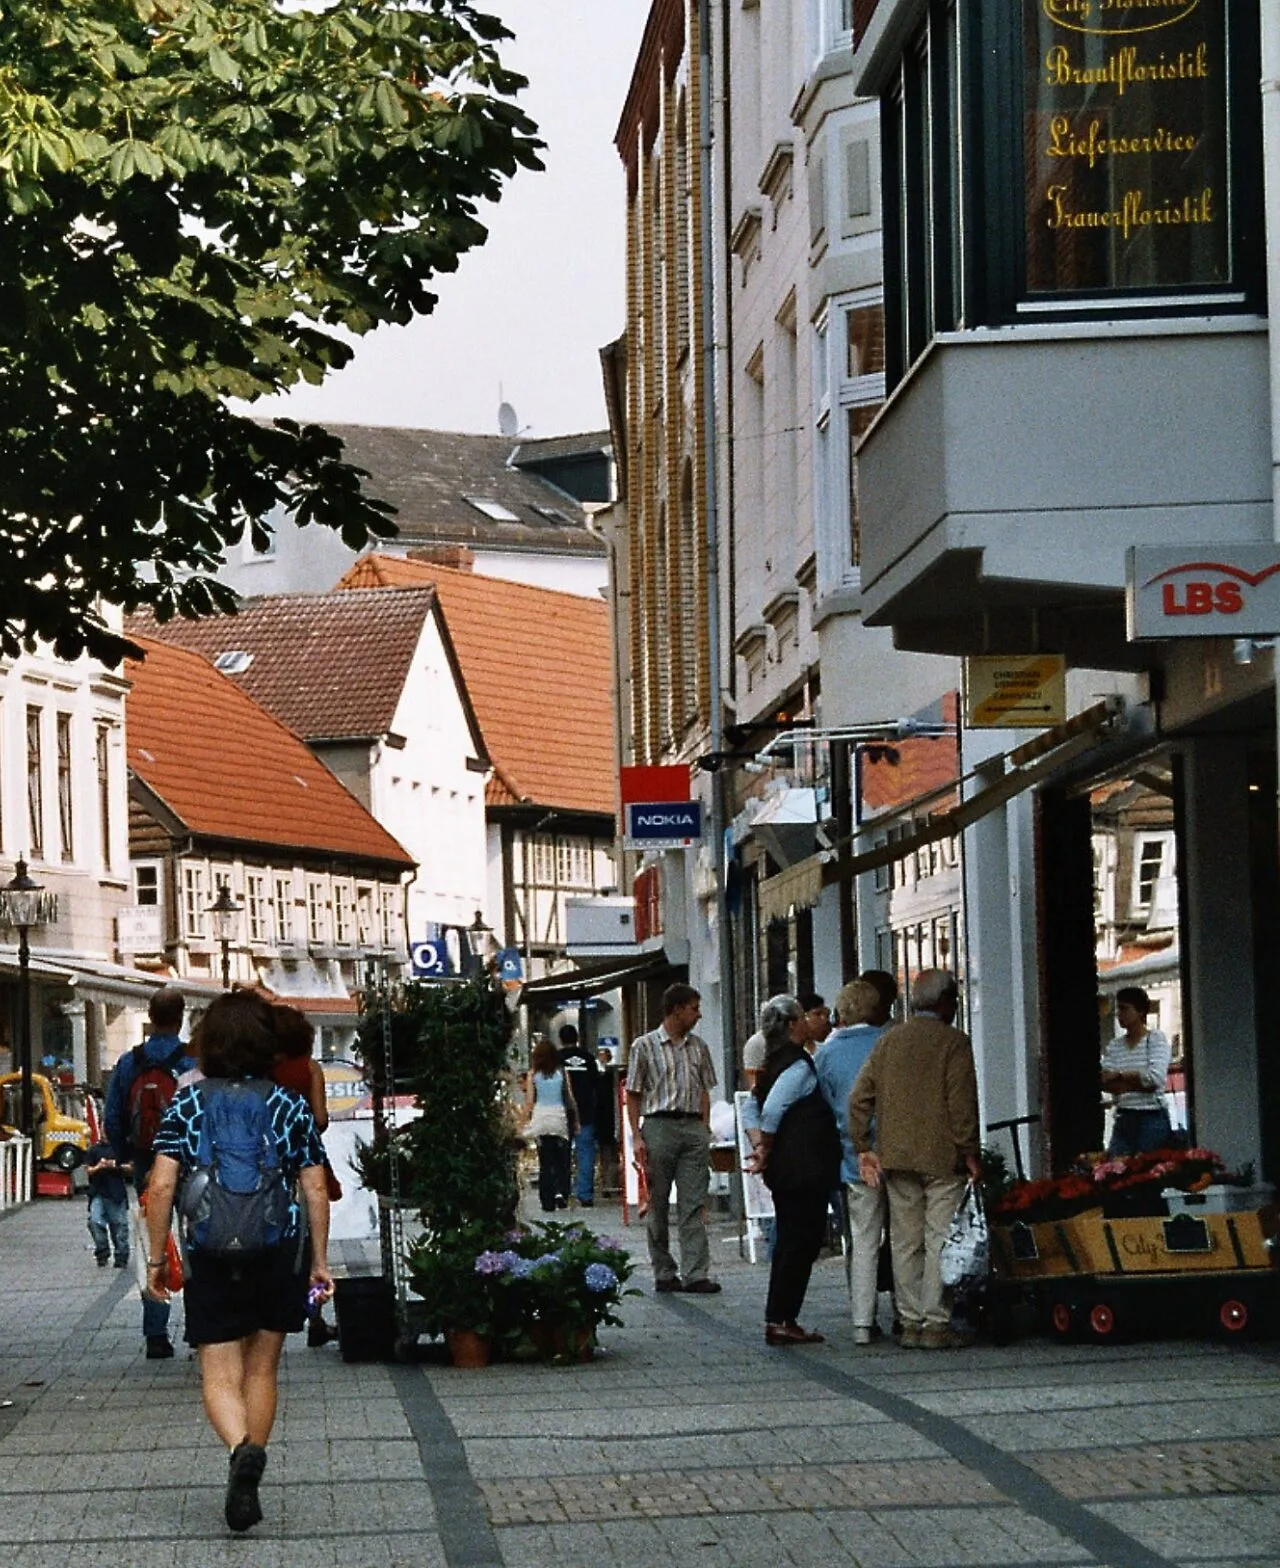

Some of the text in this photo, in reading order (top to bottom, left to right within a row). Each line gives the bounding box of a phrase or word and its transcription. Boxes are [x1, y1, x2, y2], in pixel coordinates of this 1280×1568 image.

[1046, 42, 1208, 95] Brautfloristik
[1047, 116, 1198, 168] Lieferservice
[1048, 185, 1212, 239] Trauerfloristik
[1163, 582, 1244, 615] LBS
[637, 814, 695, 826] NOKIA
[413, 944, 444, 973] O2
